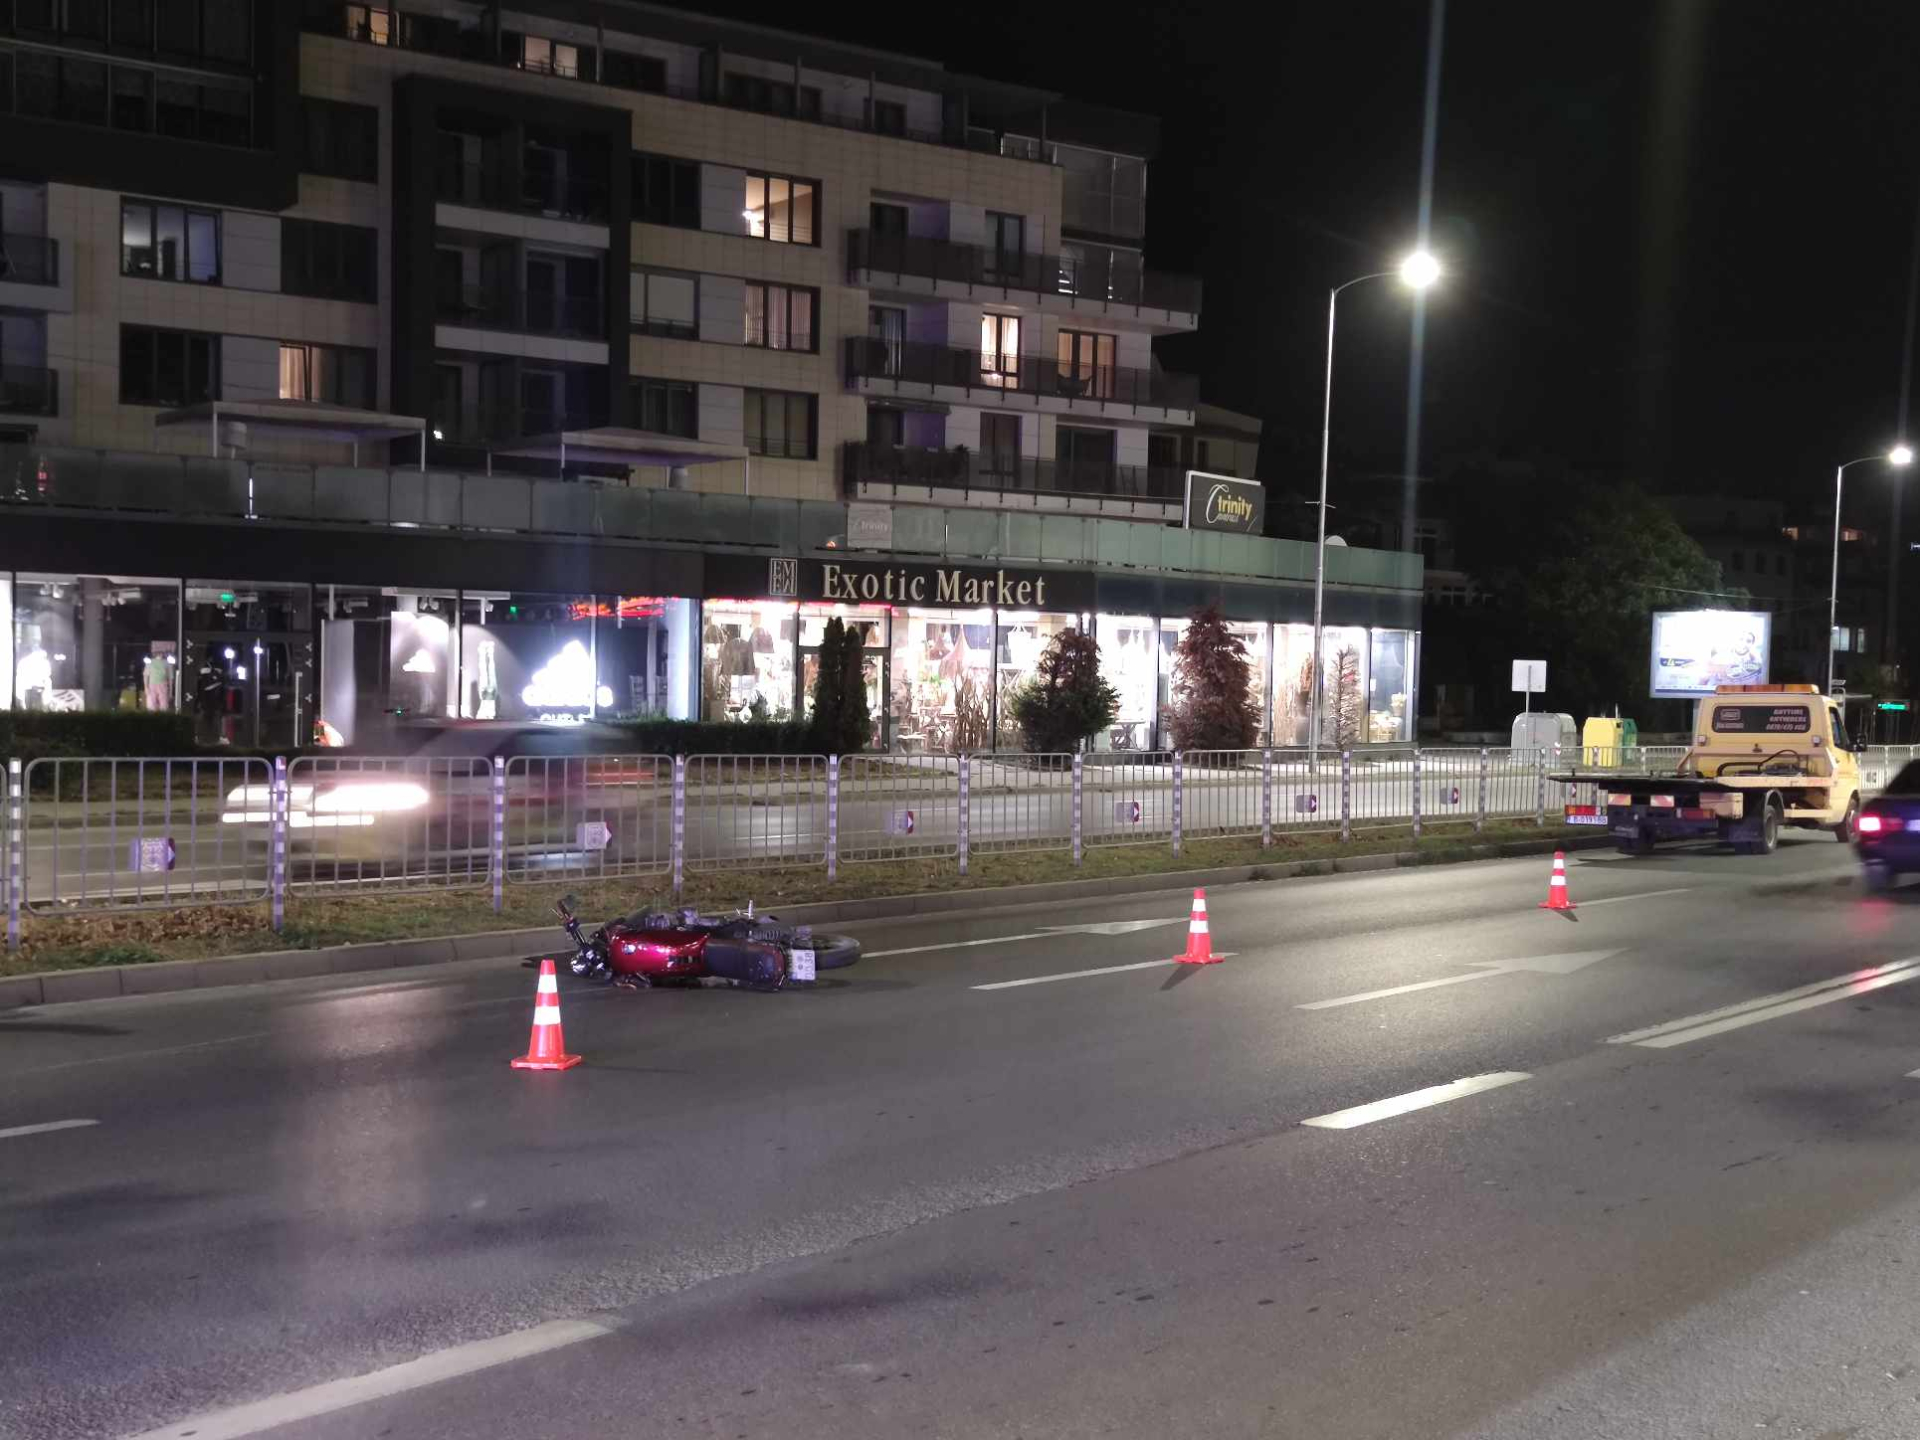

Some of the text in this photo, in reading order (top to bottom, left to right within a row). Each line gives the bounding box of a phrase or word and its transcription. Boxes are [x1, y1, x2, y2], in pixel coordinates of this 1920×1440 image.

[1217, 494, 1253, 521] trinity
[822, 564, 1047, 606] Exotic Market
